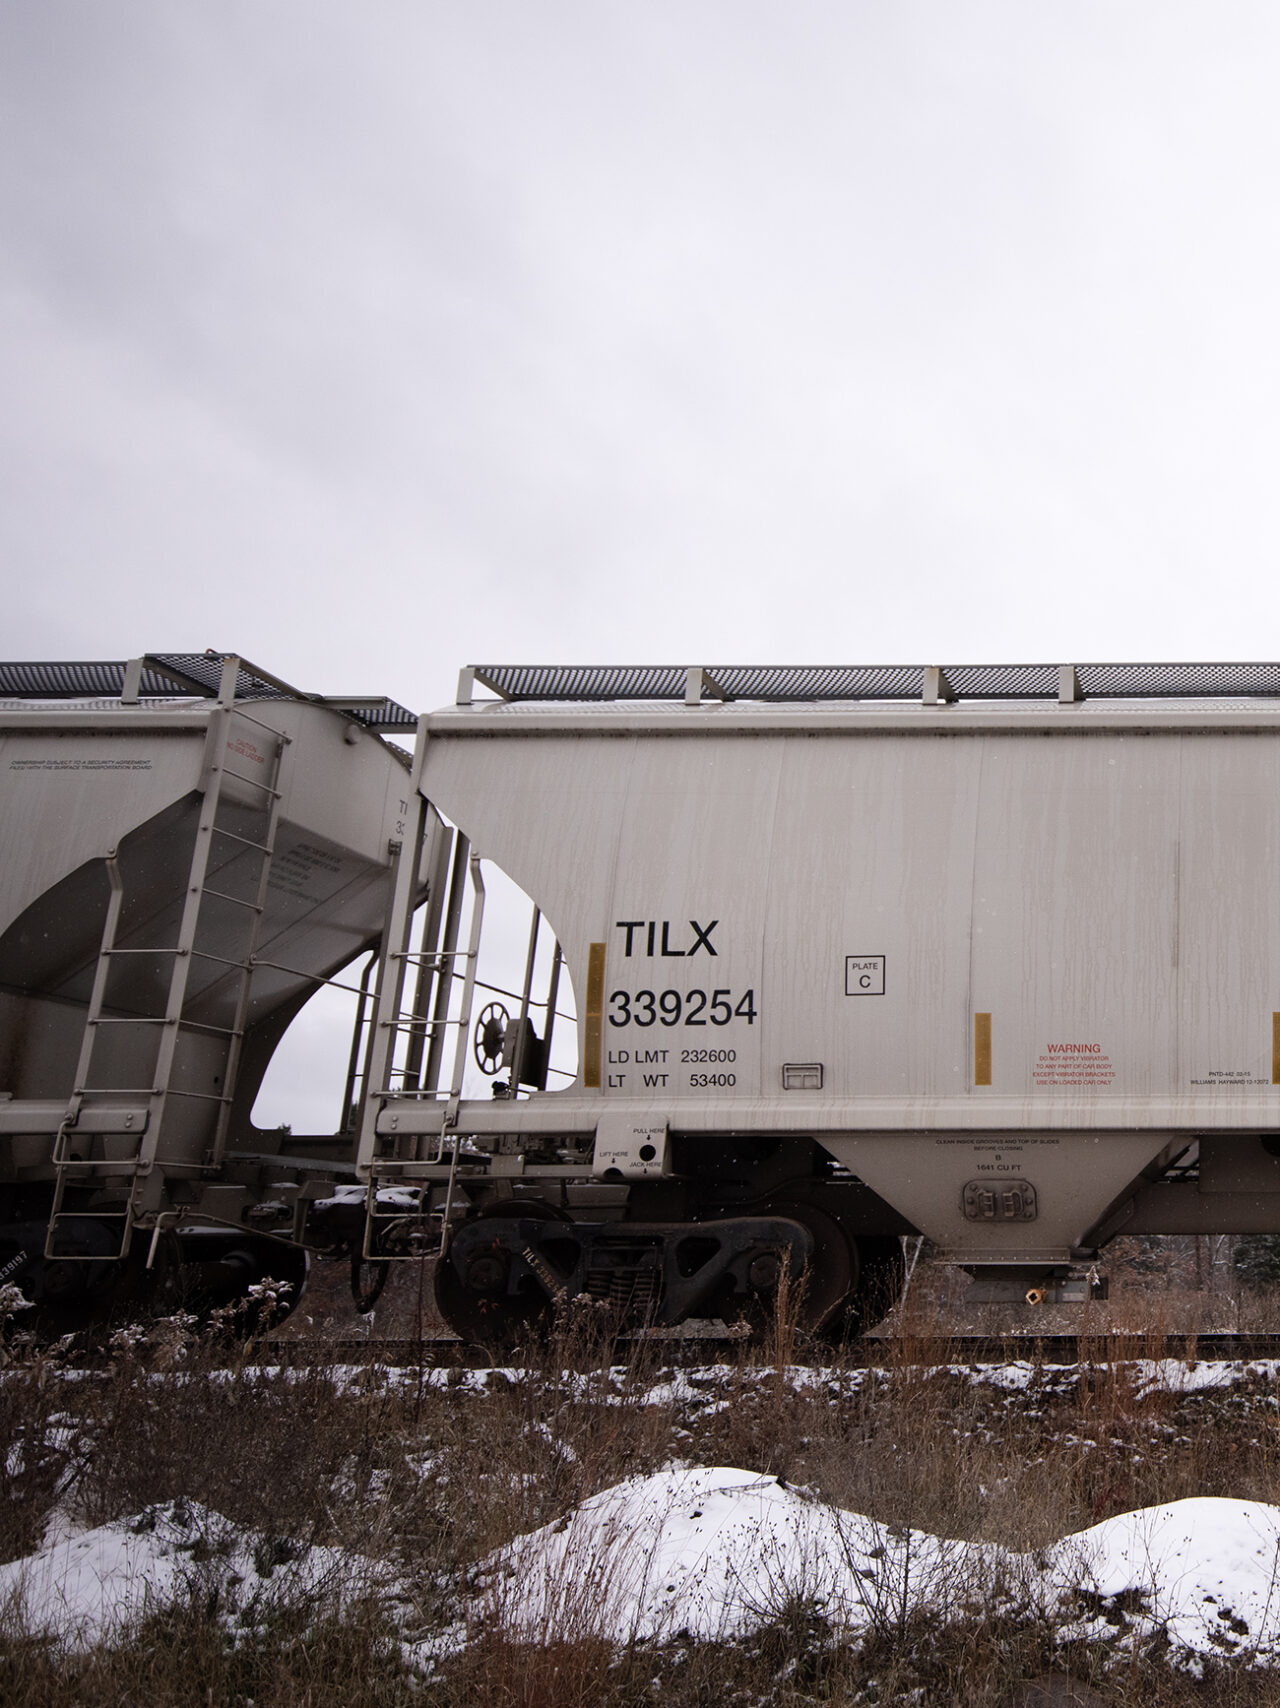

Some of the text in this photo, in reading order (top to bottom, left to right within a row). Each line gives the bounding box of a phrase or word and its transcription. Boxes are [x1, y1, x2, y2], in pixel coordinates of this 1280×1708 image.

[616, 920, 719, 957] TILX
[852, 962, 878, 970] PLATE
[859, 975, 871, 988] C
[608, 990, 758, 1027] 339254
[1047, 1044, 1101, 1053] WARNING
[608, 1050, 737, 1063] LD LMT 232600
[608, 1074, 737, 1088] LT WT 53400
[522, 1247, 540, 1267] TILX
